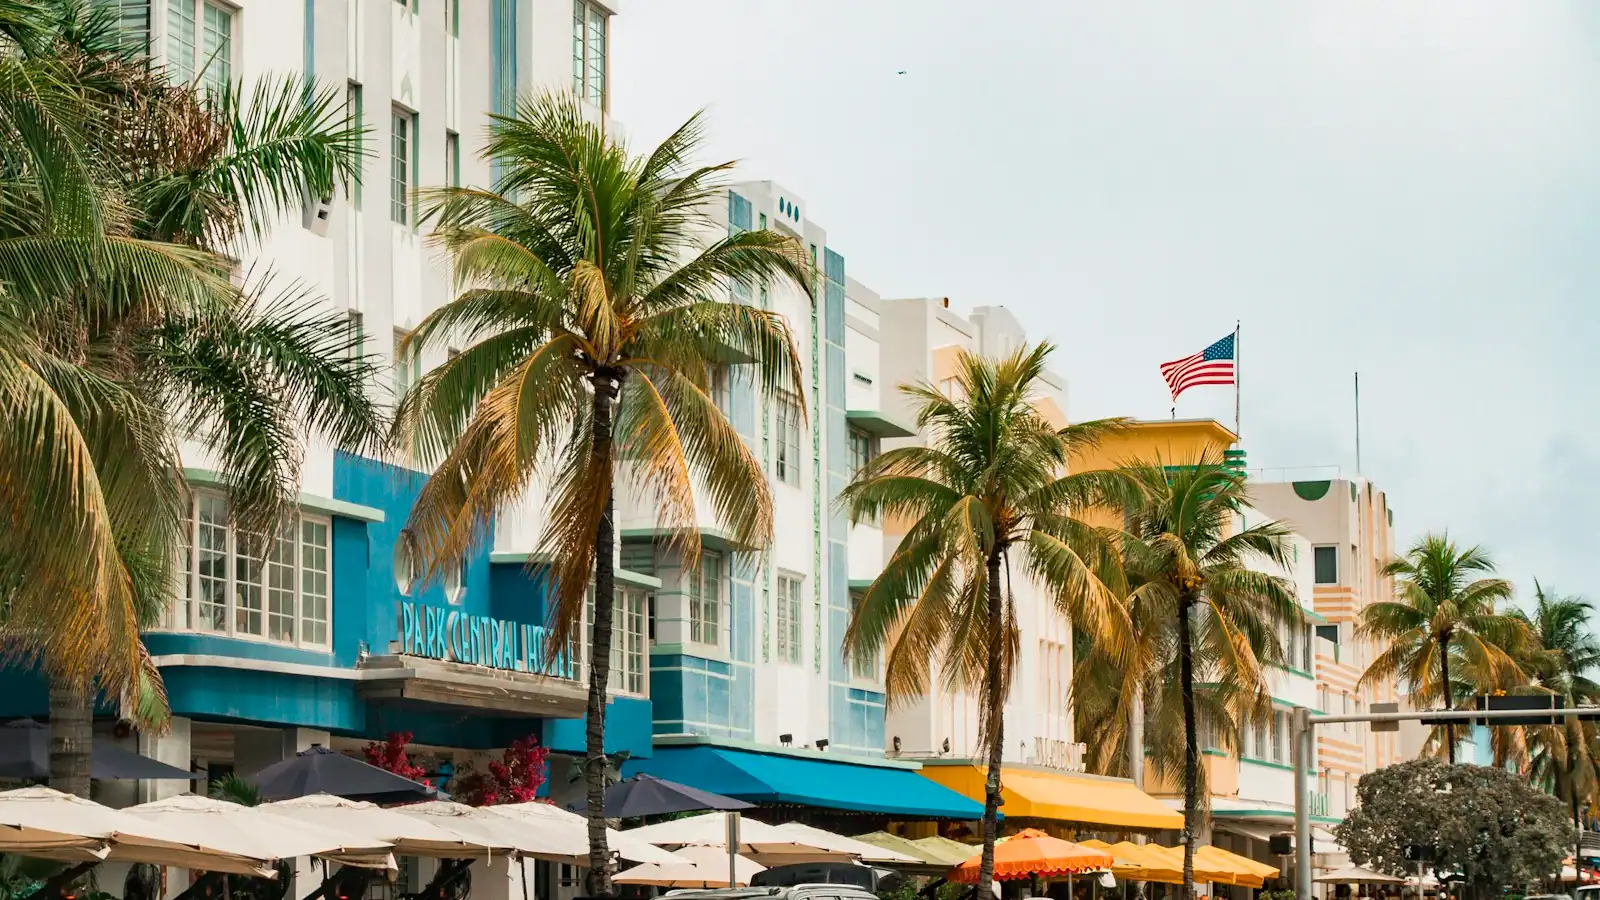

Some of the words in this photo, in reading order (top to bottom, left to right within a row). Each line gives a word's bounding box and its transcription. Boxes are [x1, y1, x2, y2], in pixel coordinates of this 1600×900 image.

[402, 601, 446, 659] PARK
[449, 611, 520, 671] CENTRAL
[526, 624, 573, 680] HOEL
